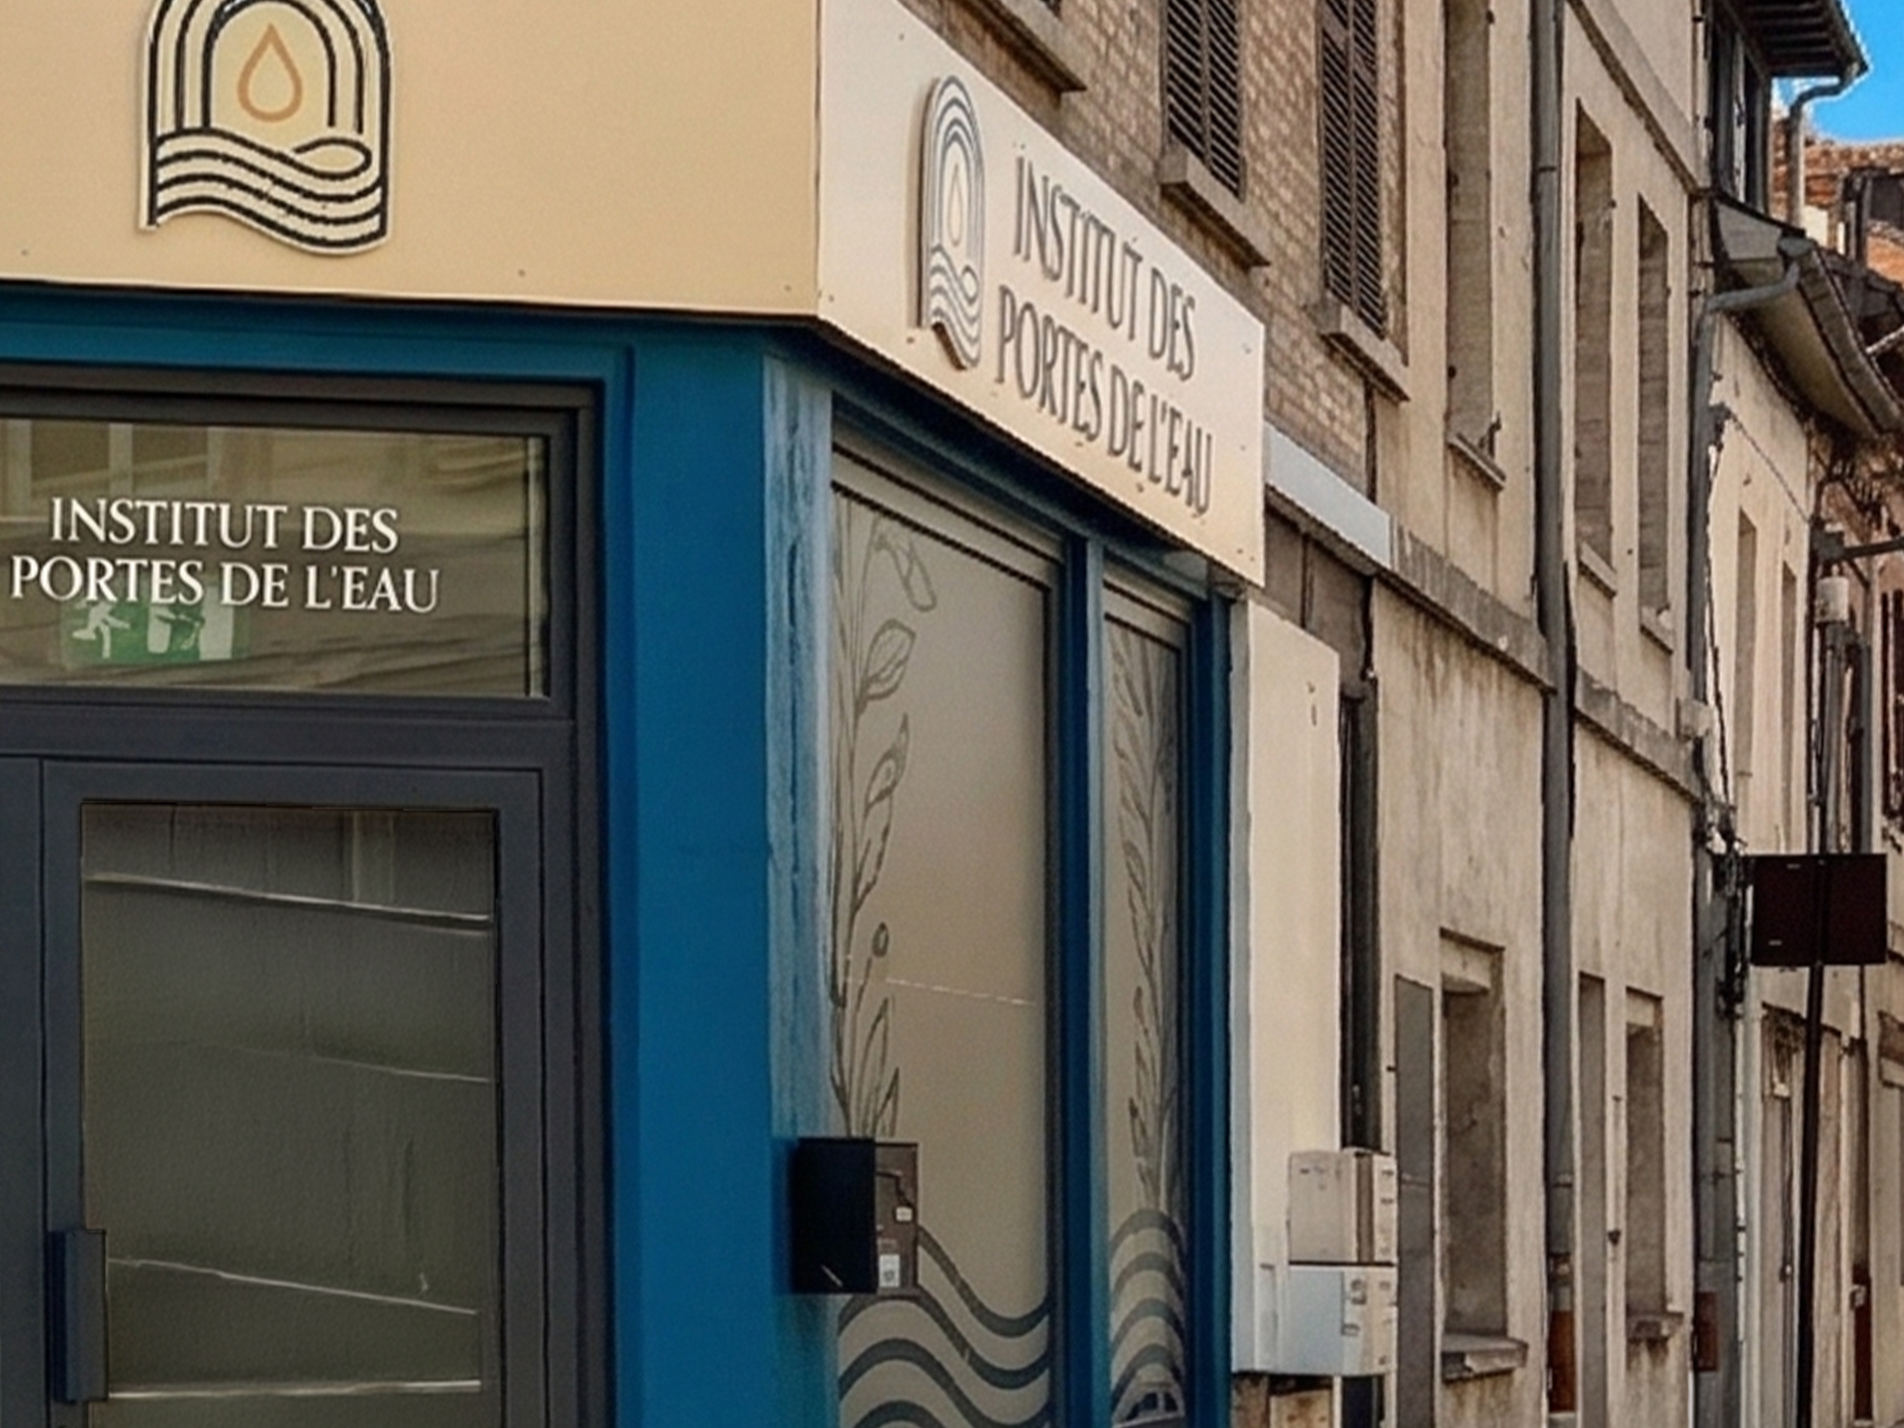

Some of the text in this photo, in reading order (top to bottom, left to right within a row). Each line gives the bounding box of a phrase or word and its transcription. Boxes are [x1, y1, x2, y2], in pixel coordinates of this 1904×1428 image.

[1013, 154, 1196, 382] INSTITUT DES
[994, 283, 1213, 518] PORTES DE L'EAU
[9, 555, 440, 614] PORTES DE L'EAU
[49, 496, 400, 553] INSTITUT DES
